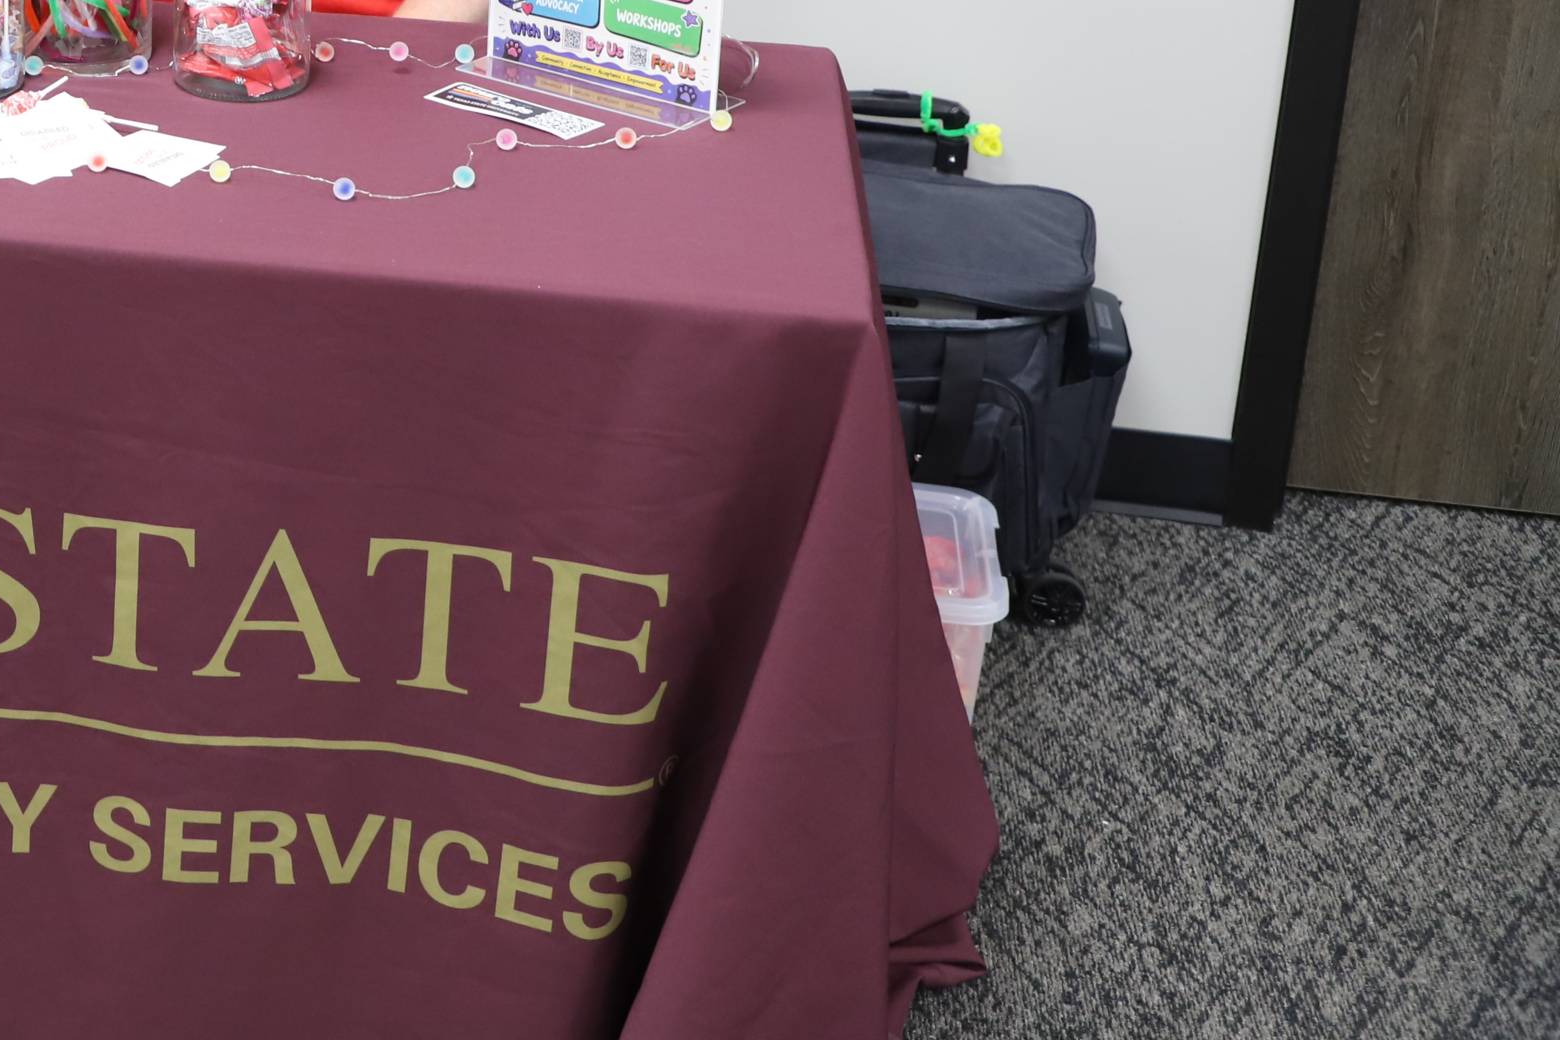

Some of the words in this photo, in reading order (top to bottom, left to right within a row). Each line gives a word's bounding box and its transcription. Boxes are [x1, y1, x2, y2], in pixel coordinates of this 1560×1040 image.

[509, 19, 541, 38] With
[544, 25, 561, 42] Us
[616, 9, 682, 38] WORKSHOPS
[585, 36, 604, 57] By
[606, 40, 624, 59] Us
[651, 54, 675, 75] For
[678, 61, 696, 81] Us
[89, 794, 633, 941] SERVICES
